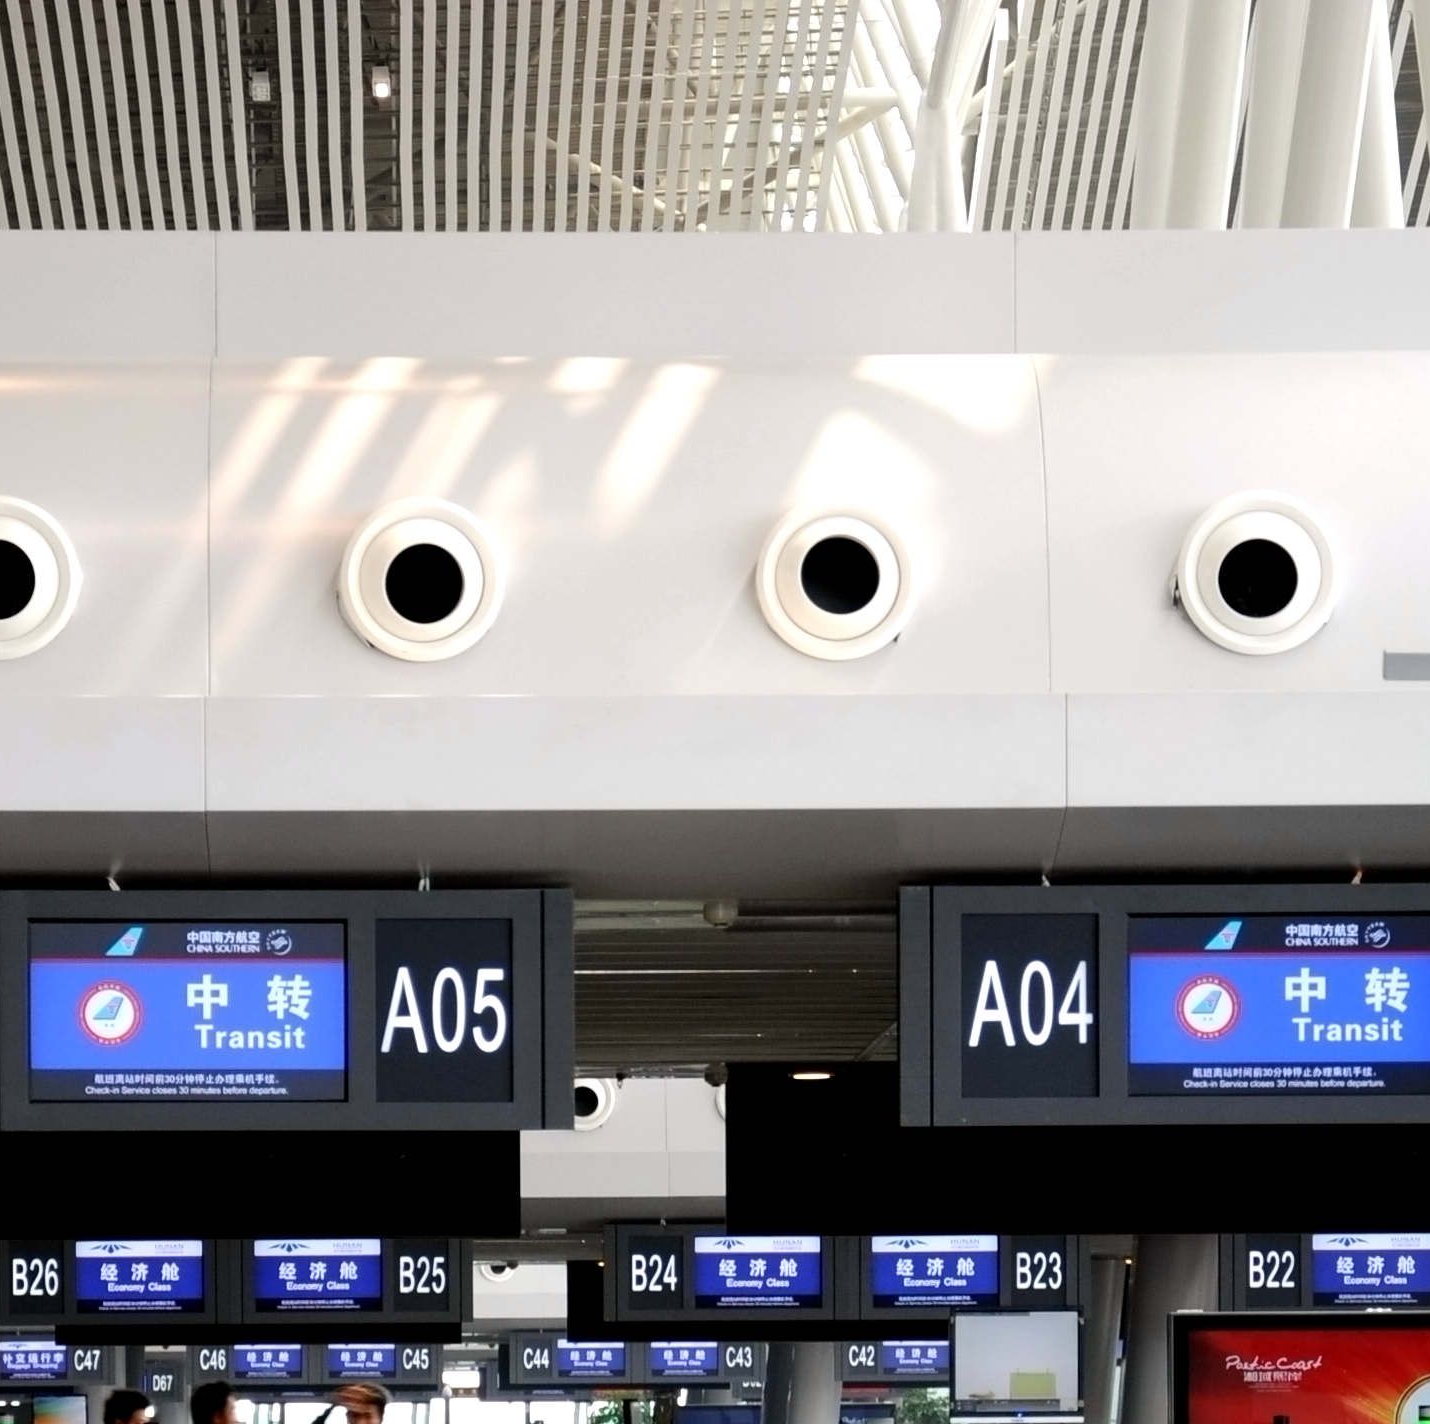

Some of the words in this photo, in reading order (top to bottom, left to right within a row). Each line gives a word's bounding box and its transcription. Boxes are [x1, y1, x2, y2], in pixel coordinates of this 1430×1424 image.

[187, 974, 312, 1019] 中转
[1285, 967, 1410, 1018] 中转
[381, 967, 506, 1053] A05
[969, 960, 1093, 1047] A04
[195, 1024, 305, 1048] Transit
[1292, 1017, 1402, 1041] Transit
[121, 1086, 150, 1094] Service
[179, 1086, 189, 1094] 30
[223, 1086, 247, 1094] before
[1250, 1080, 1274, 1088] closes
[1321, 1079, 1344, 1087] before
[101, 1263, 179, 1281] 经济舱
[279, 1261, 357, 1280] 经济舱
[400, 1256, 445, 1293] B25
[632, 1254, 677, 1291] B24
[719, 1259, 797, 1277] 经济舱
[896, 1258, 974, 1276] 经济舱
[1017, 1252, 1062, 1289] B23
[1249, 1251, 1294, 1288] B22
[1337, 1256, 1415, 1274] 经济舱
[13, 1259, 58, 1296] B26
[74, 1350, 100, 1370] C47
[200, 1349, 226, 1370] C46
[403, 1348, 428, 1369] C45
[524, 1348, 549, 1369] C44
[726, 1347, 752, 1367] C43
[849, 1345, 874, 1366] C42
[153, 1375, 172, 1391] D67
